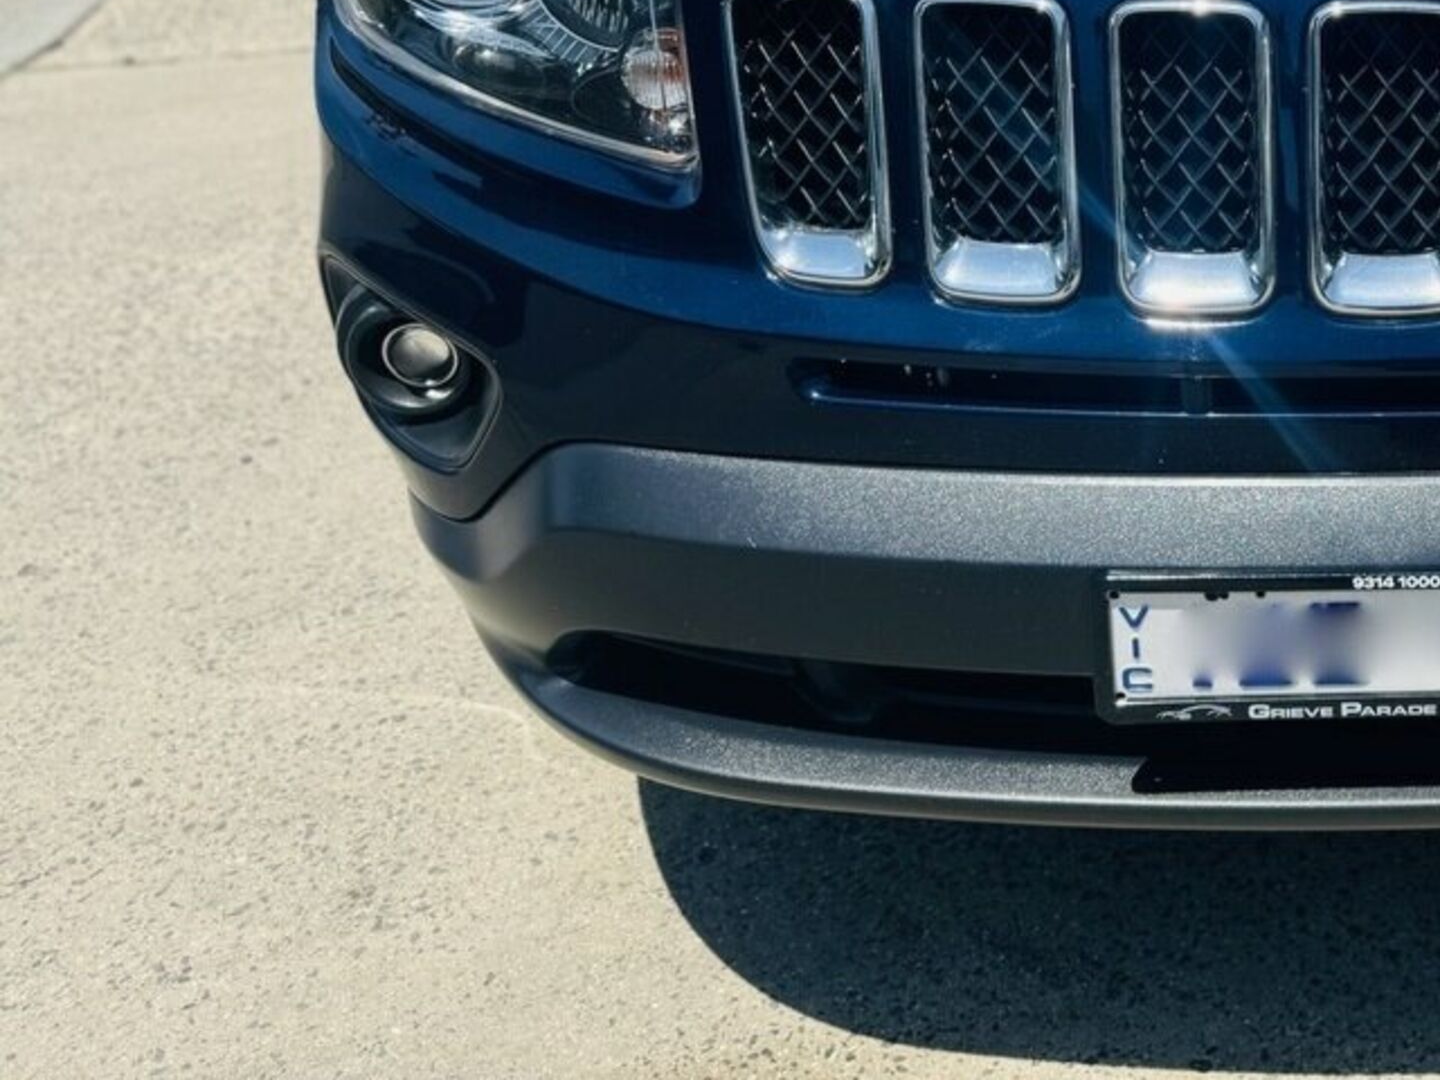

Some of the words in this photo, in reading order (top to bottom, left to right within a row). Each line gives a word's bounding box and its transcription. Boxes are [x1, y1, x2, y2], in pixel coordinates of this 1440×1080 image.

[1352, 575, 1395, 589] 9314
[1397, 575, 1440, 589] 1000
[1119, 605, 1153, 690] VIC
